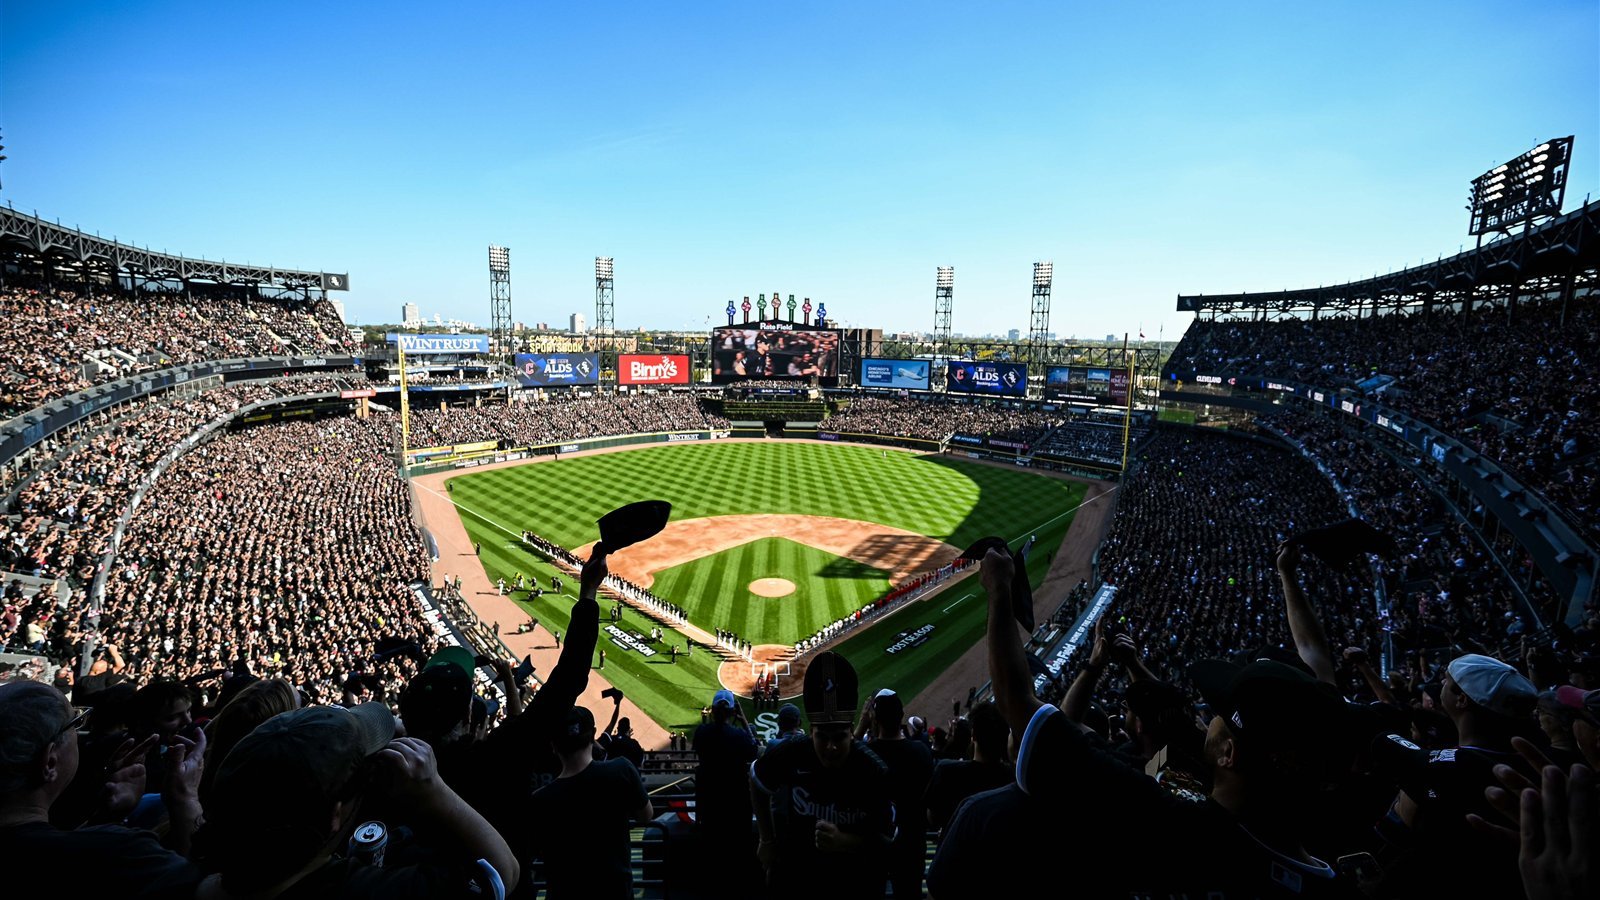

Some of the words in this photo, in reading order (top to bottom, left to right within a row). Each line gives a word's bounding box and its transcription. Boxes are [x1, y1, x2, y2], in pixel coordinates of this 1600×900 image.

[759, 322, 776, 330] Rate
[776, 323, 793, 331] Field
[400, 335, 480, 350] WINTRUST
[529, 342, 583, 353] SPORTSBOOK
[303, 358, 327, 366] CHICAGO
[544, 363, 573, 374] ALDS
[630, 359, 678, 379] Binny's
[972, 371, 1000, 382] ALDS
[1196, 374, 1222, 384] CLEVELAND
[1086, 605, 1101, 621] CHICAGO
[1077, 625, 1086, 633] OF
[1081, 619, 1092, 628] THE
[604, 624, 656, 657] POSTSEASON
[885, 623, 936, 654] POSTSEASON
[1069, 631, 1083, 644] HOME
[1056, 642, 1077, 660] Field
